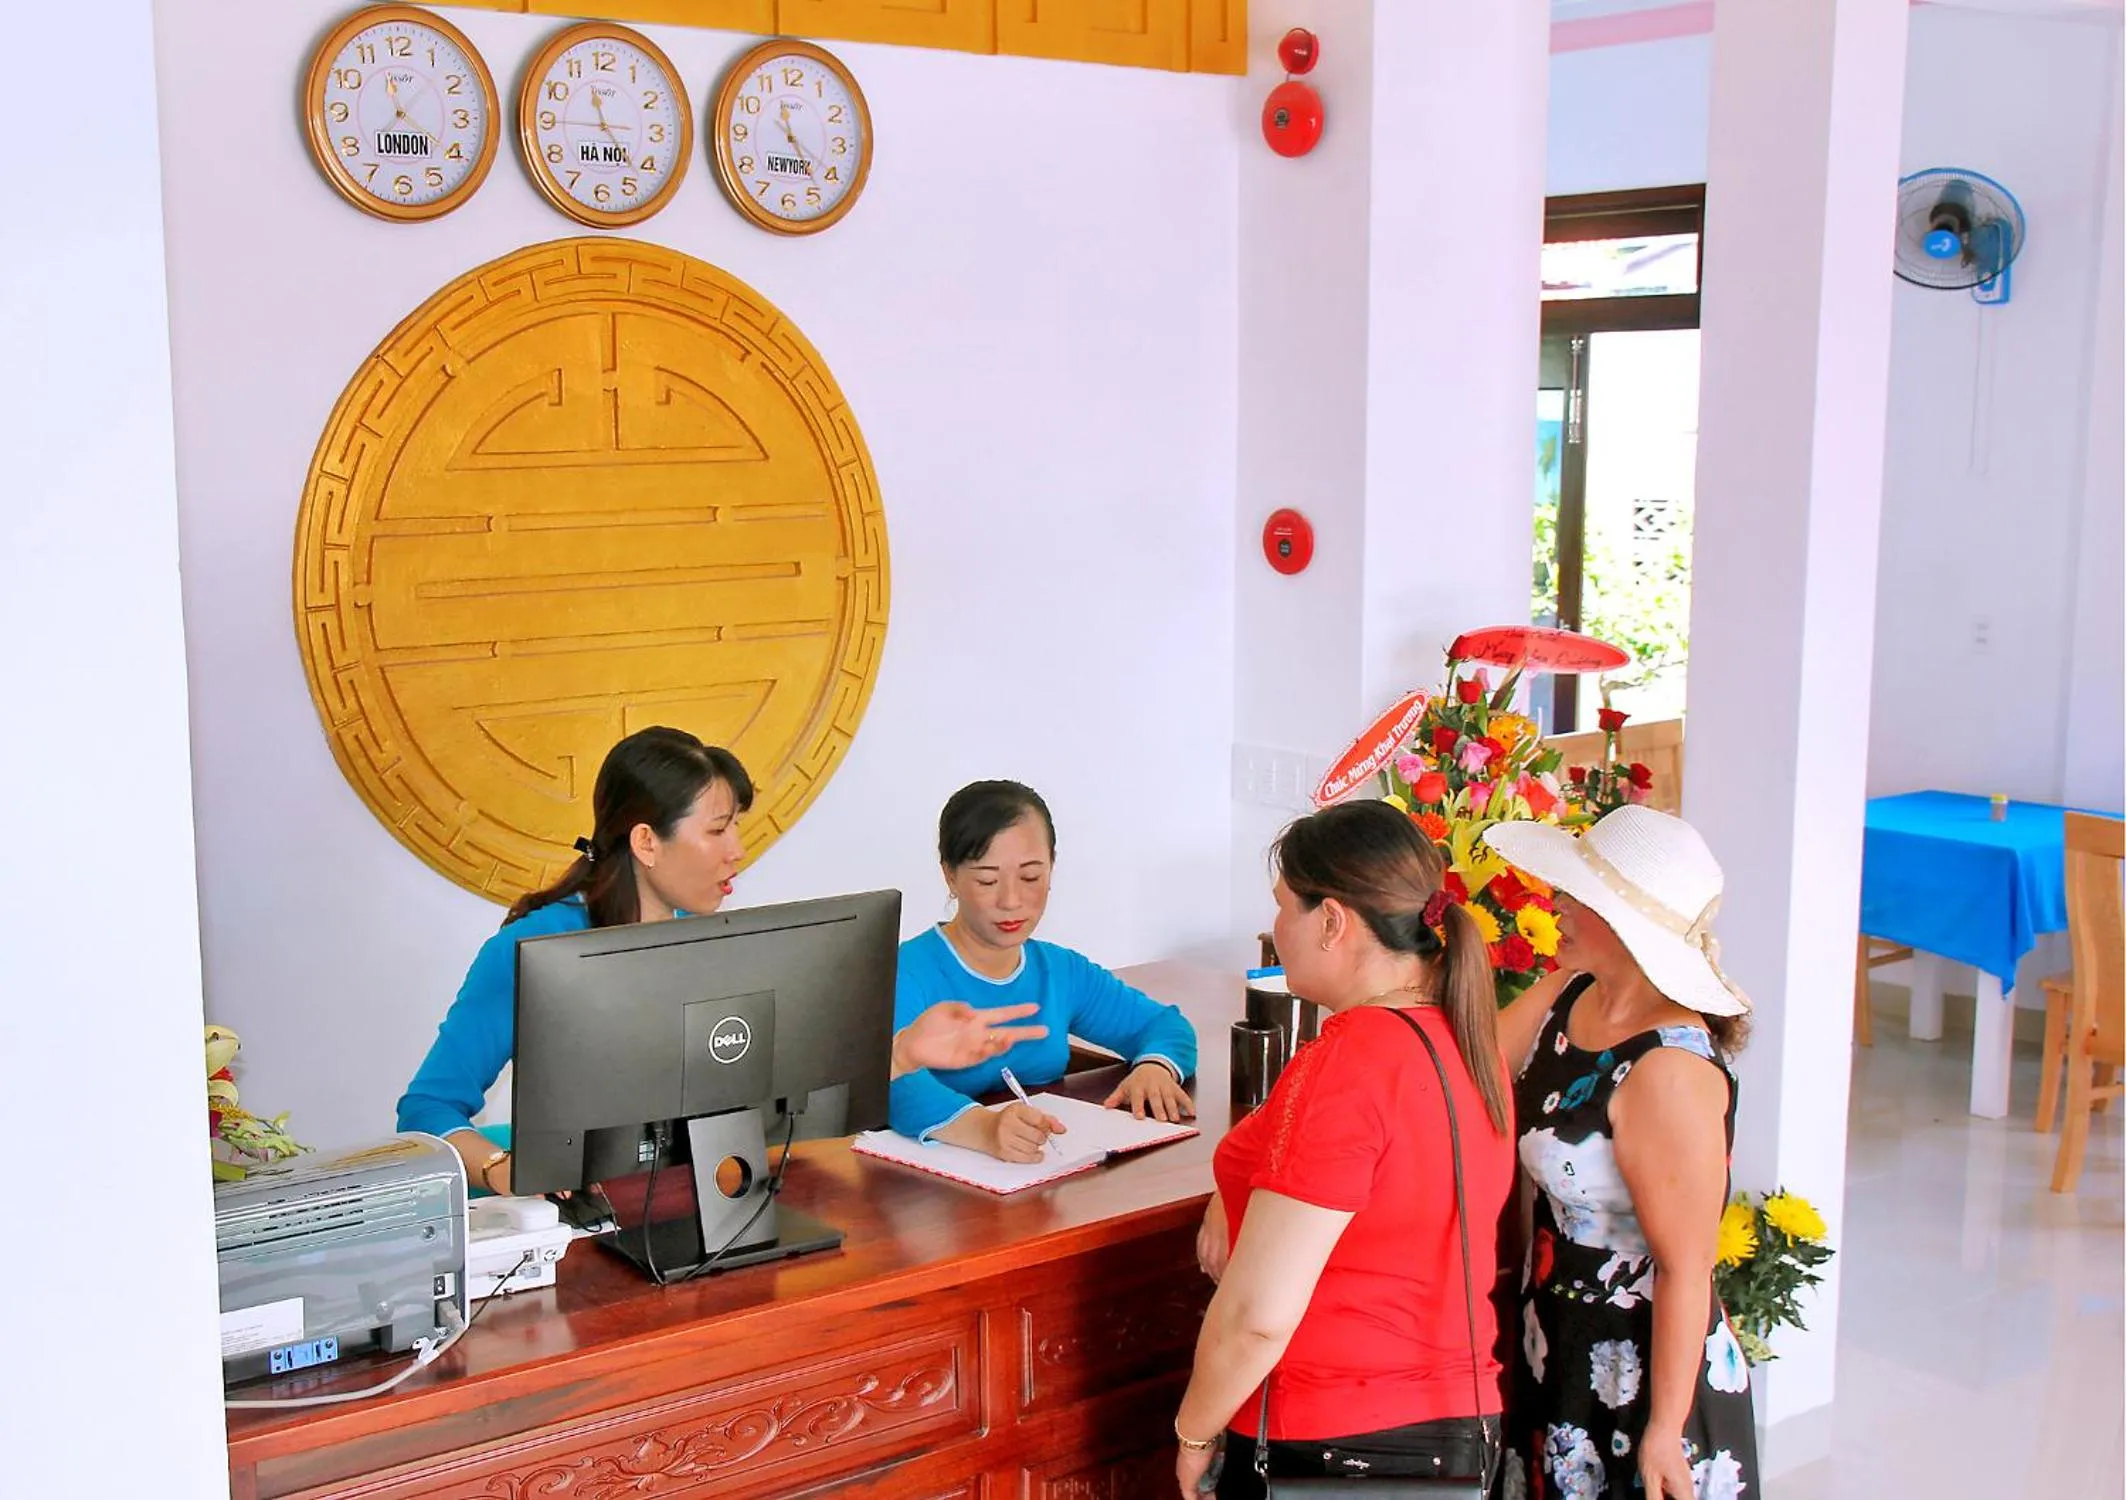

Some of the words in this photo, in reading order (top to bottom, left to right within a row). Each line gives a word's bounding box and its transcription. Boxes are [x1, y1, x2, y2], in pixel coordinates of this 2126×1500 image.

[356, 43, 375, 65] 11
[385, 35, 414, 57] 12
[427, 47, 435, 68] 1
[592, 51, 616, 73] 12
[566, 57, 582, 79] 11
[628, 64, 637, 84] 1
[781, 67, 804, 87] 12
[333, 68, 362, 90] 10
[445, 74, 462, 95] 2
[757, 74, 773, 93] 11
[815, 80, 823, 98] 1
[545, 80, 569, 102] 10
[643, 90, 659, 110] 2
[329, 101, 349, 123] 9
[738, 94, 761, 115] 10
[828, 104, 843, 124] 2
[453, 108, 470, 130] 3
[539, 111, 557, 131] 9
[649, 123, 665, 143] 3
[732, 123, 748, 143] 9
[341, 136, 360, 157] 8
[376, 132, 429, 156] LONDON
[444, 142, 464, 163] 4
[547, 144, 564, 164] 8
[831, 136, 847, 155] 3
[362, 163, 380, 184] 7
[640, 155, 657, 175] 4
[738, 156, 754, 175] 8
[824, 165, 840, 184] 4
[394, 175, 414, 196] 6
[425, 167, 443, 188] 5
[565, 170, 582, 190] 7
[621, 176, 638, 197] 5
[594, 183, 611, 203] 6
[755, 180, 770, 198] 7
[806, 187, 821, 206] 5
[781, 193, 797, 212] 6
[1374, 732, 1396, 760] Khai
[713, 1033, 746, 1048] DELL
